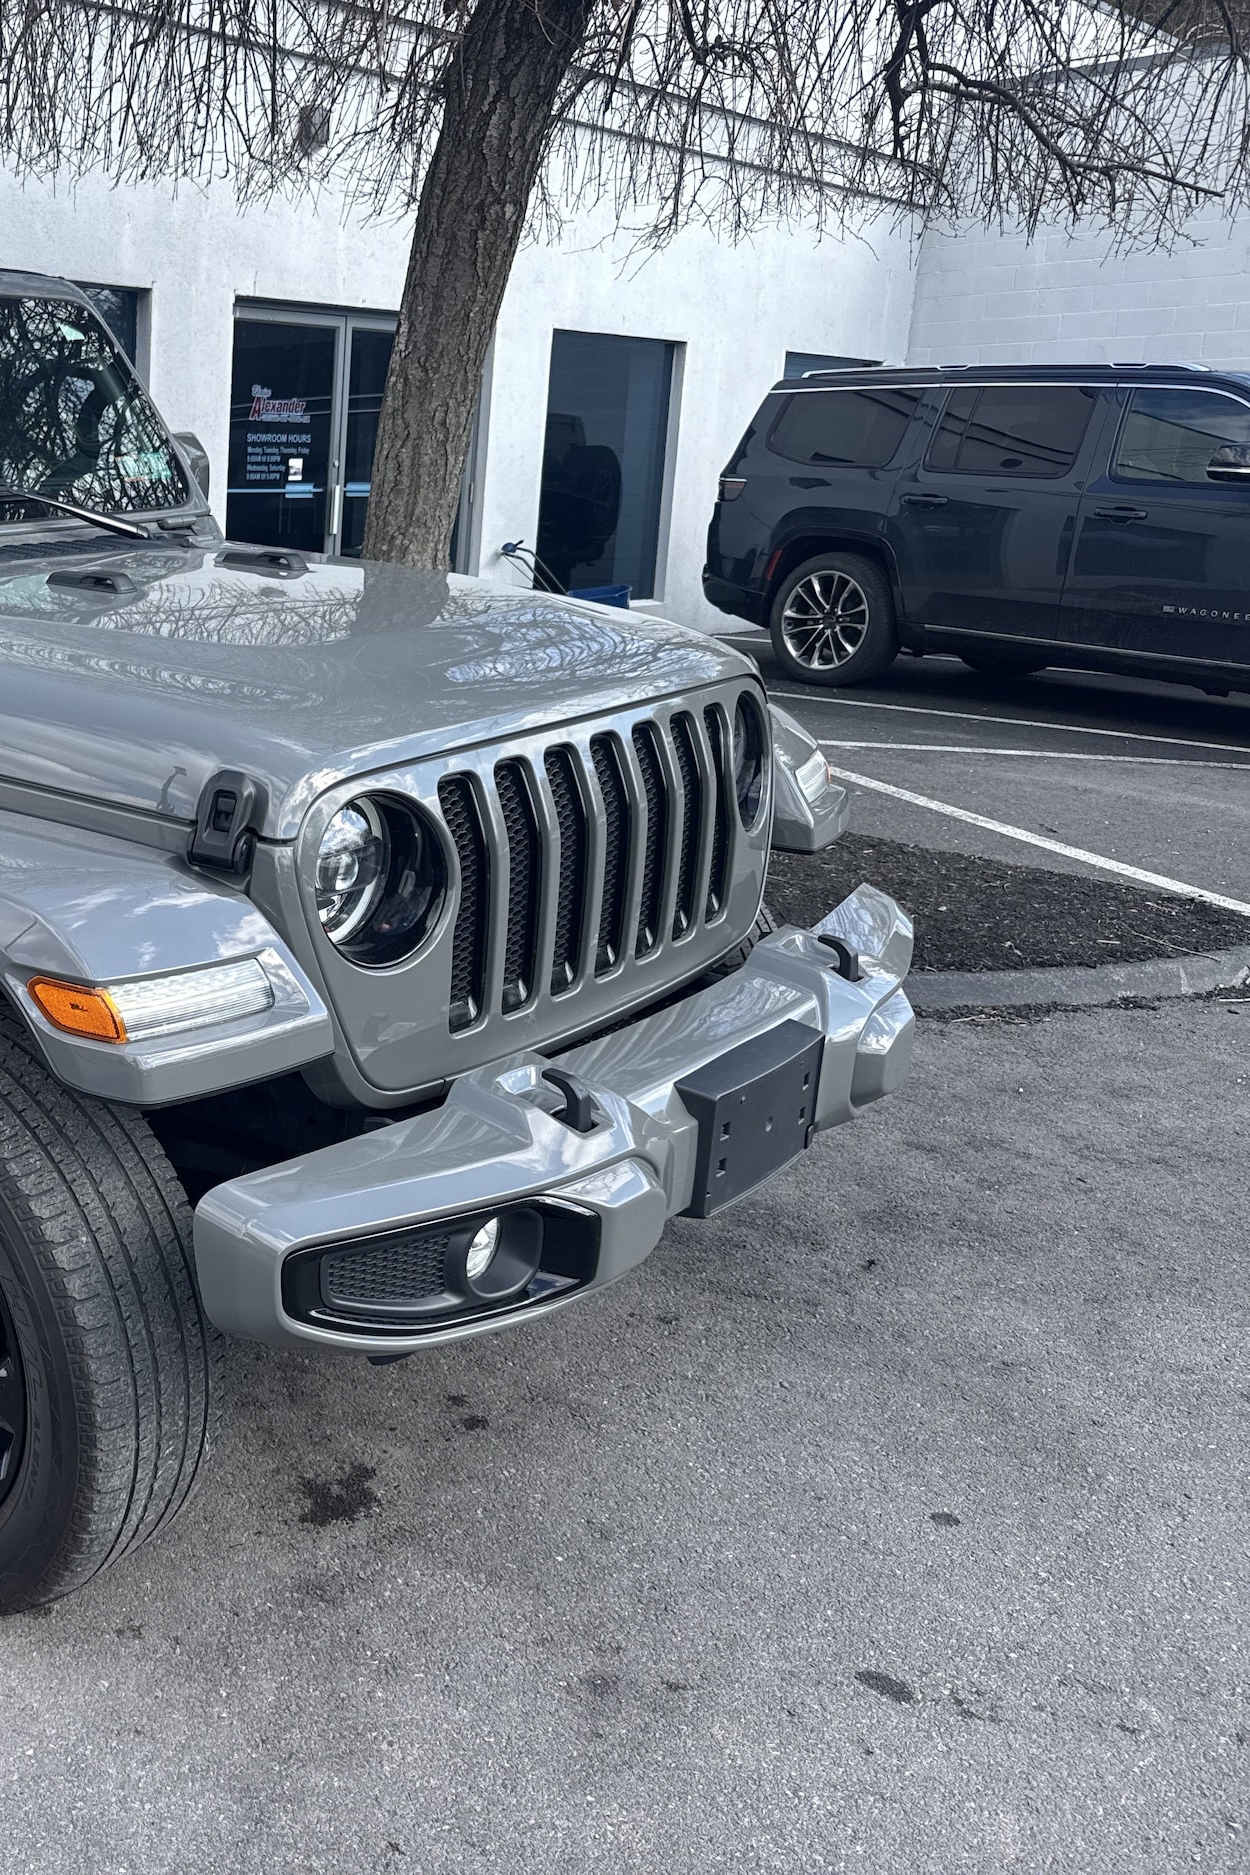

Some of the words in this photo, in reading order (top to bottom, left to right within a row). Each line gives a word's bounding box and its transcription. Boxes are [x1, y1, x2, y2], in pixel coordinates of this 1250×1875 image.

[249, 396, 306, 421] Alexander
[246, 433, 287, 443] SHOWROOM
[288, 434, 312, 444] HOURS
